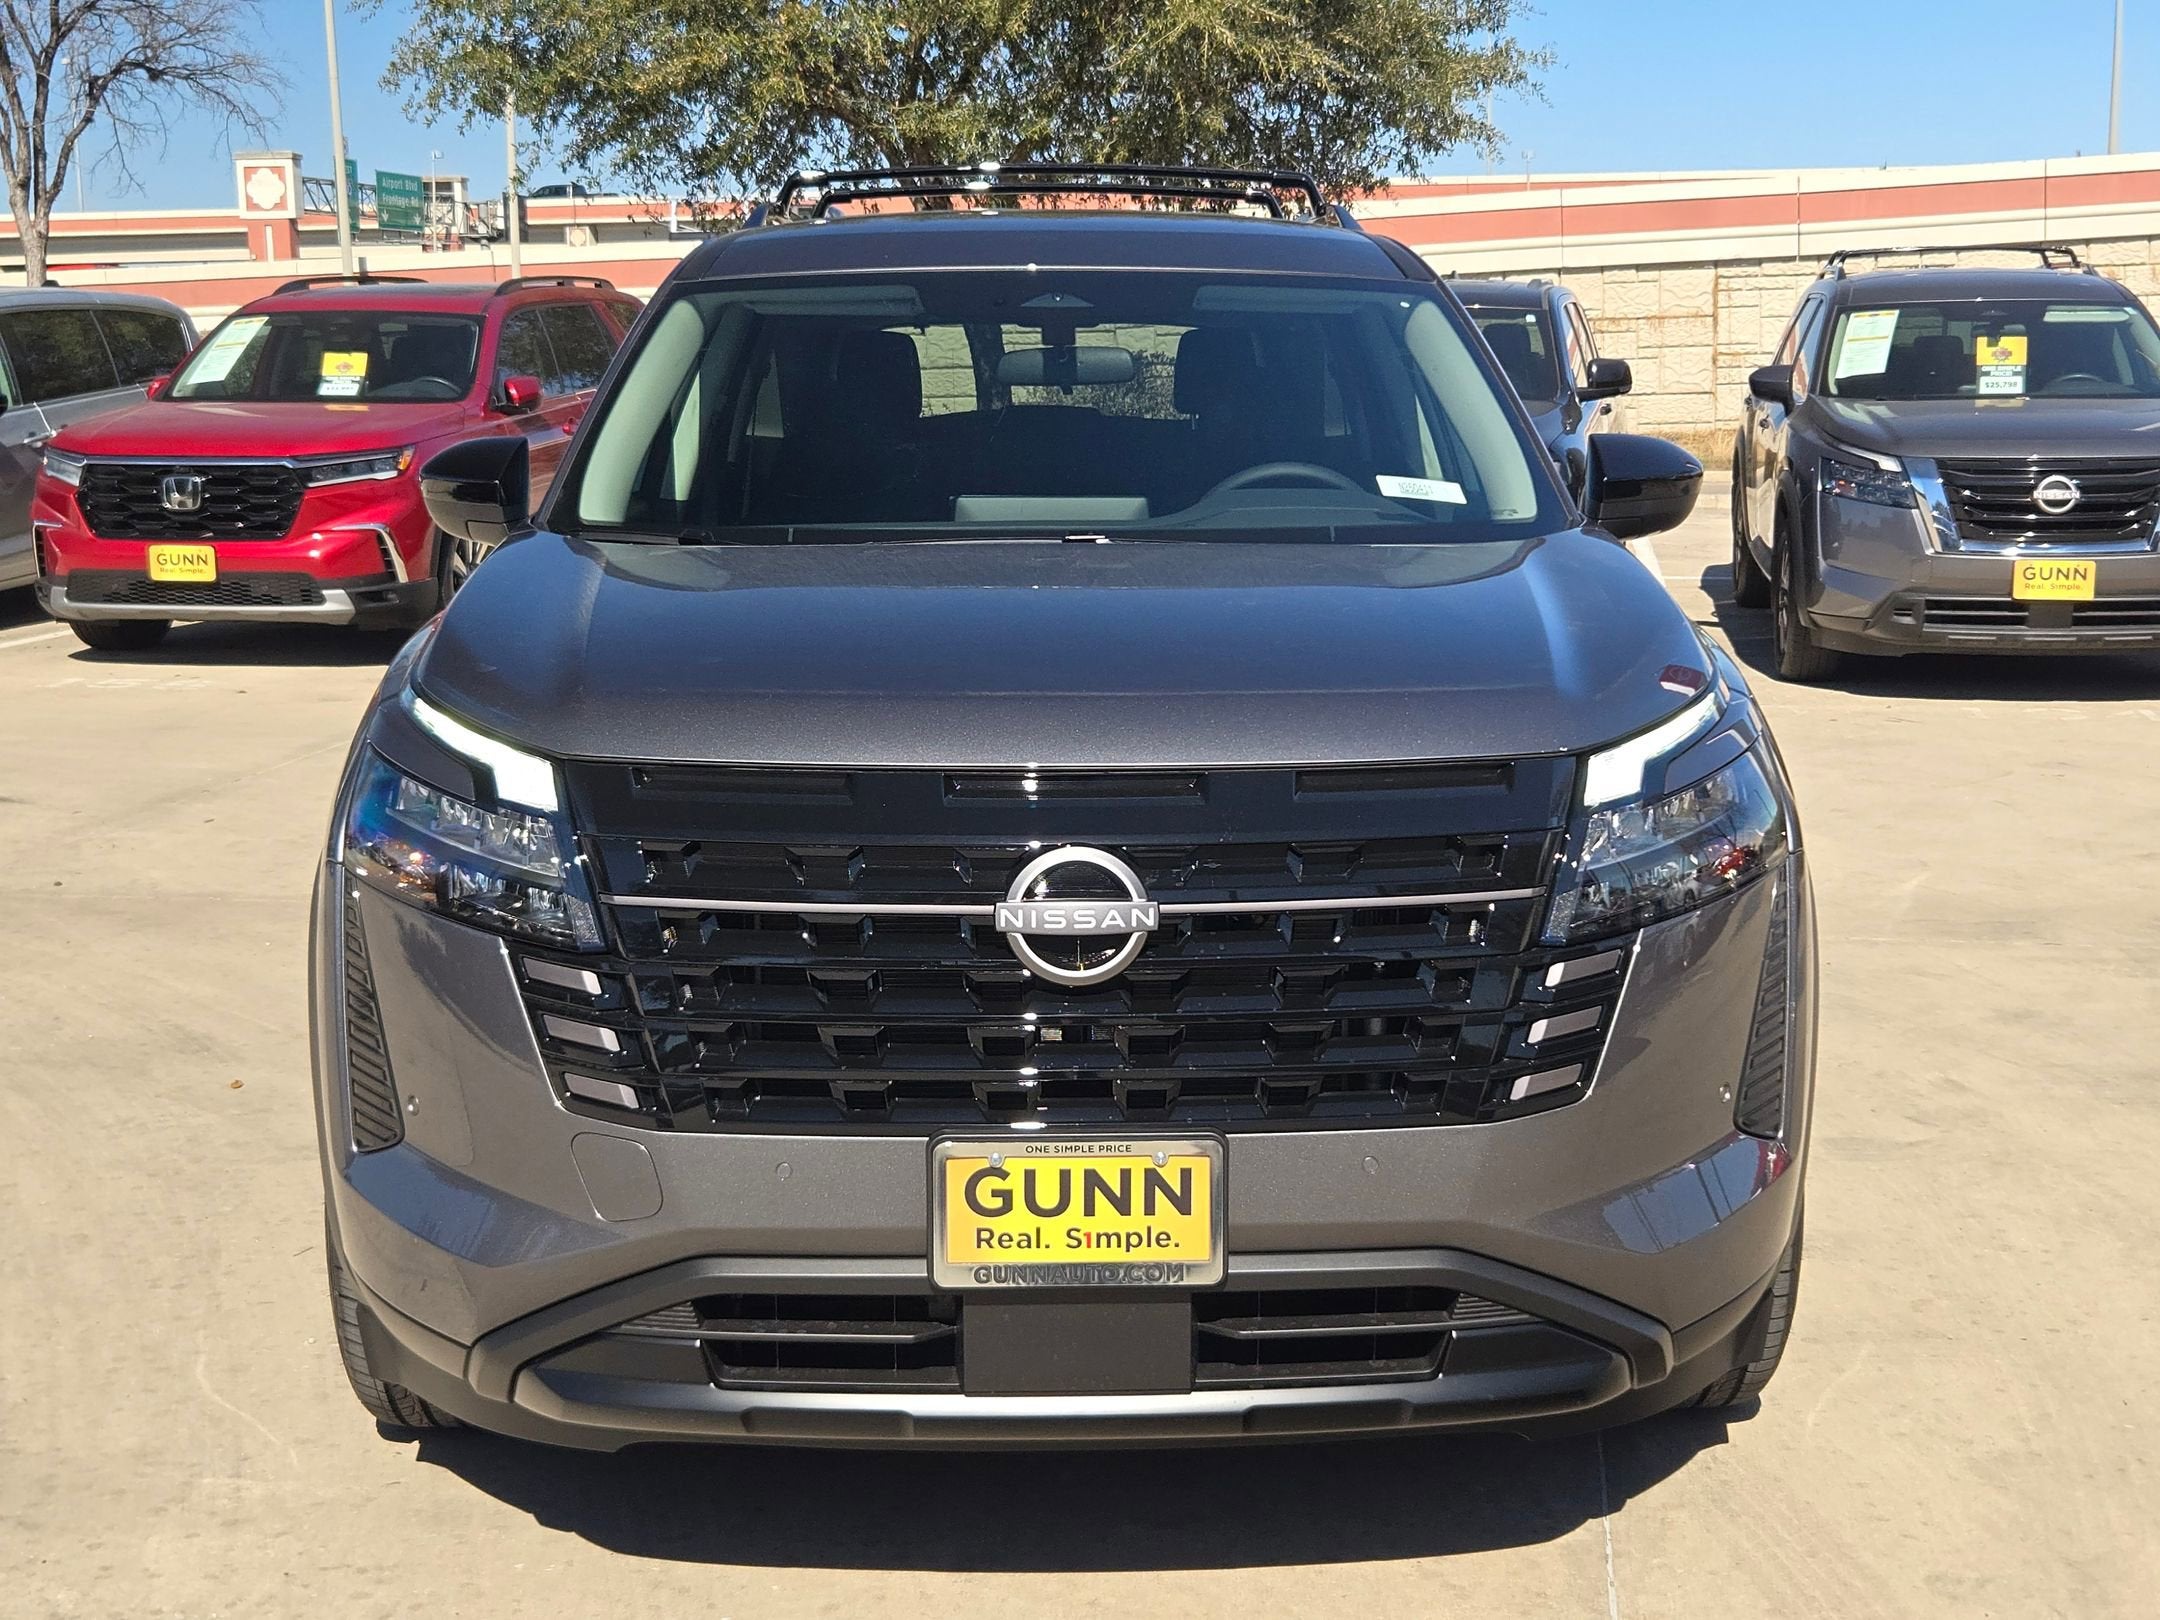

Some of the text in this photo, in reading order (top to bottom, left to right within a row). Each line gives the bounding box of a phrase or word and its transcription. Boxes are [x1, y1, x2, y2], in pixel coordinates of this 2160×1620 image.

[381, 176, 418, 191] Airport Blvd
[2033, 490, 2080, 499] NISSAN
[156, 553, 208, 566] GUNN
[2023, 566, 2087, 581] GUNN
[999, 907, 1155, 929] NISSAN
[1025, 1144, 1132, 1154] ONE SIMPLE PRICE
[964, 1166, 1193, 1218] GUNN
[976, 1226, 1051, 1249] Real.
[973, 1263, 1185, 1285] GUNNAUTO.COM
